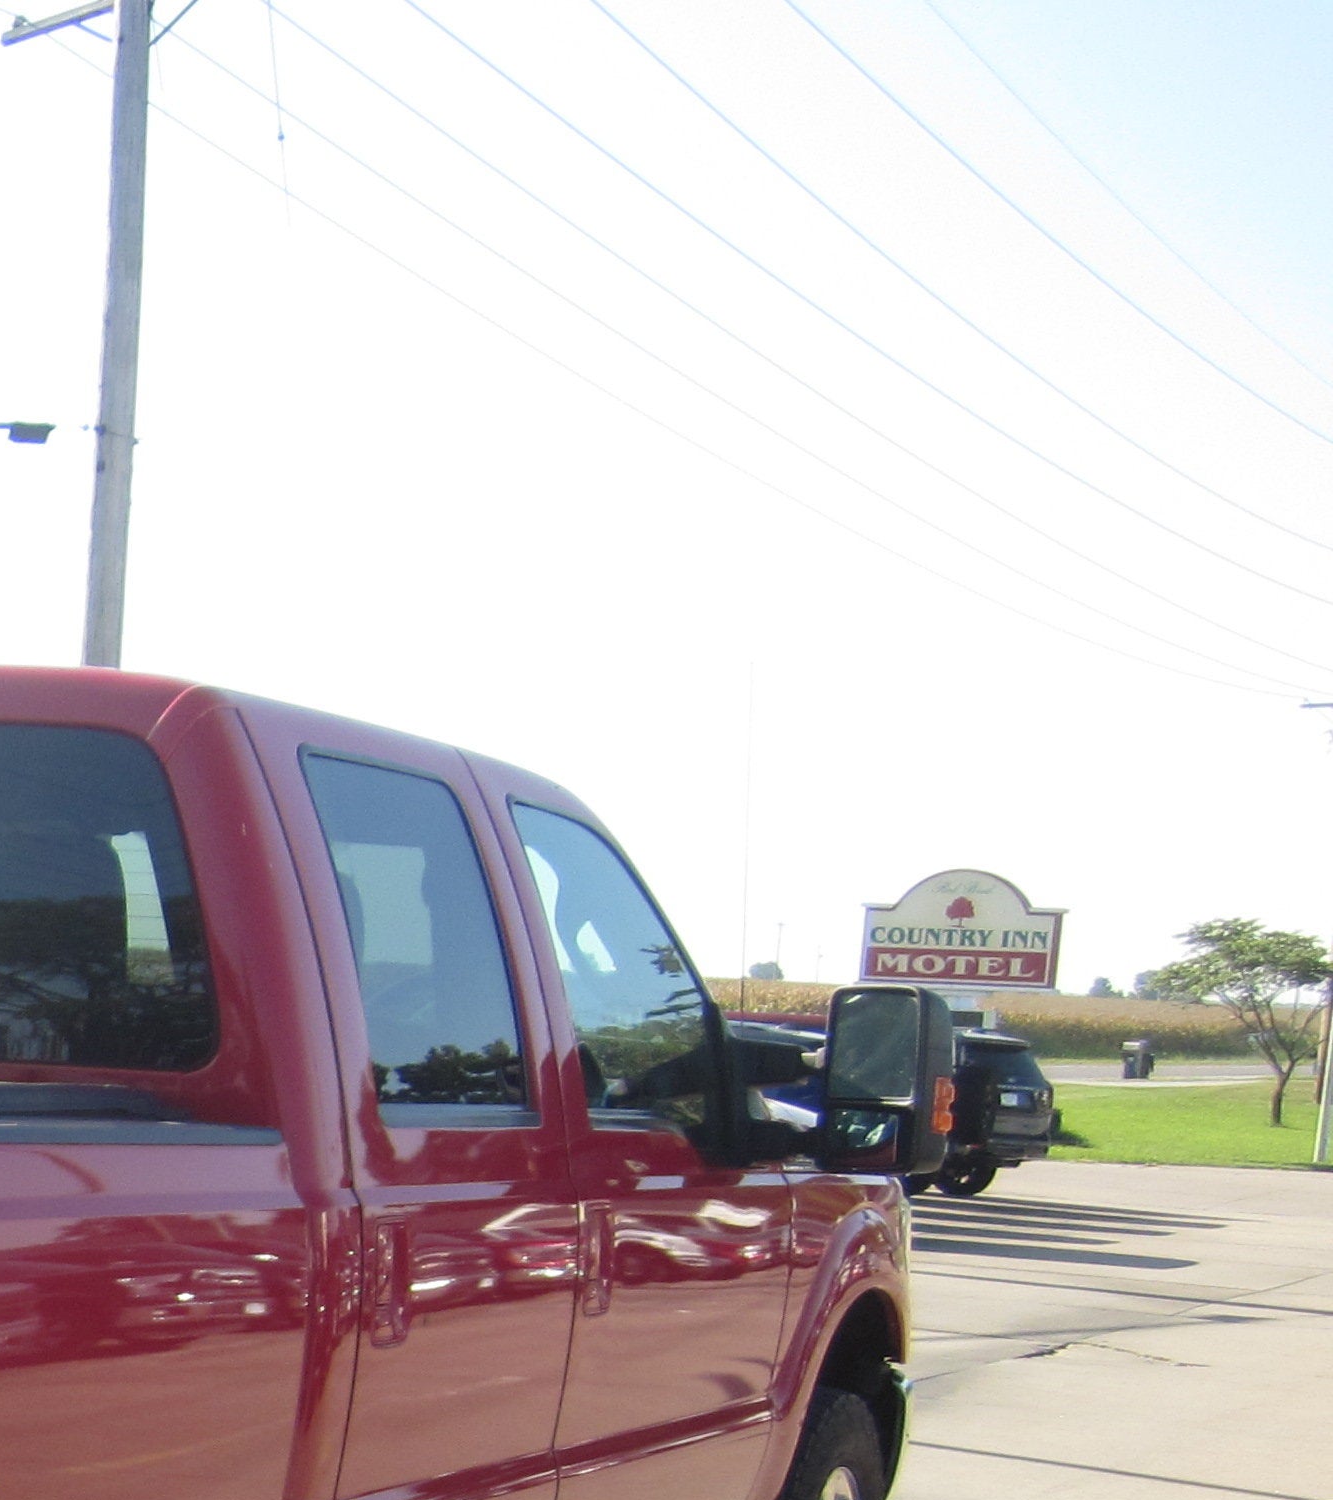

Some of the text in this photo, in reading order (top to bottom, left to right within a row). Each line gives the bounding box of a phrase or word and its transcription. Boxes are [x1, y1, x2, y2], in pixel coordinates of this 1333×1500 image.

[870, 925, 1049, 949] COUNTRY INN
[875, 952, 1035, 979] MOTEL
